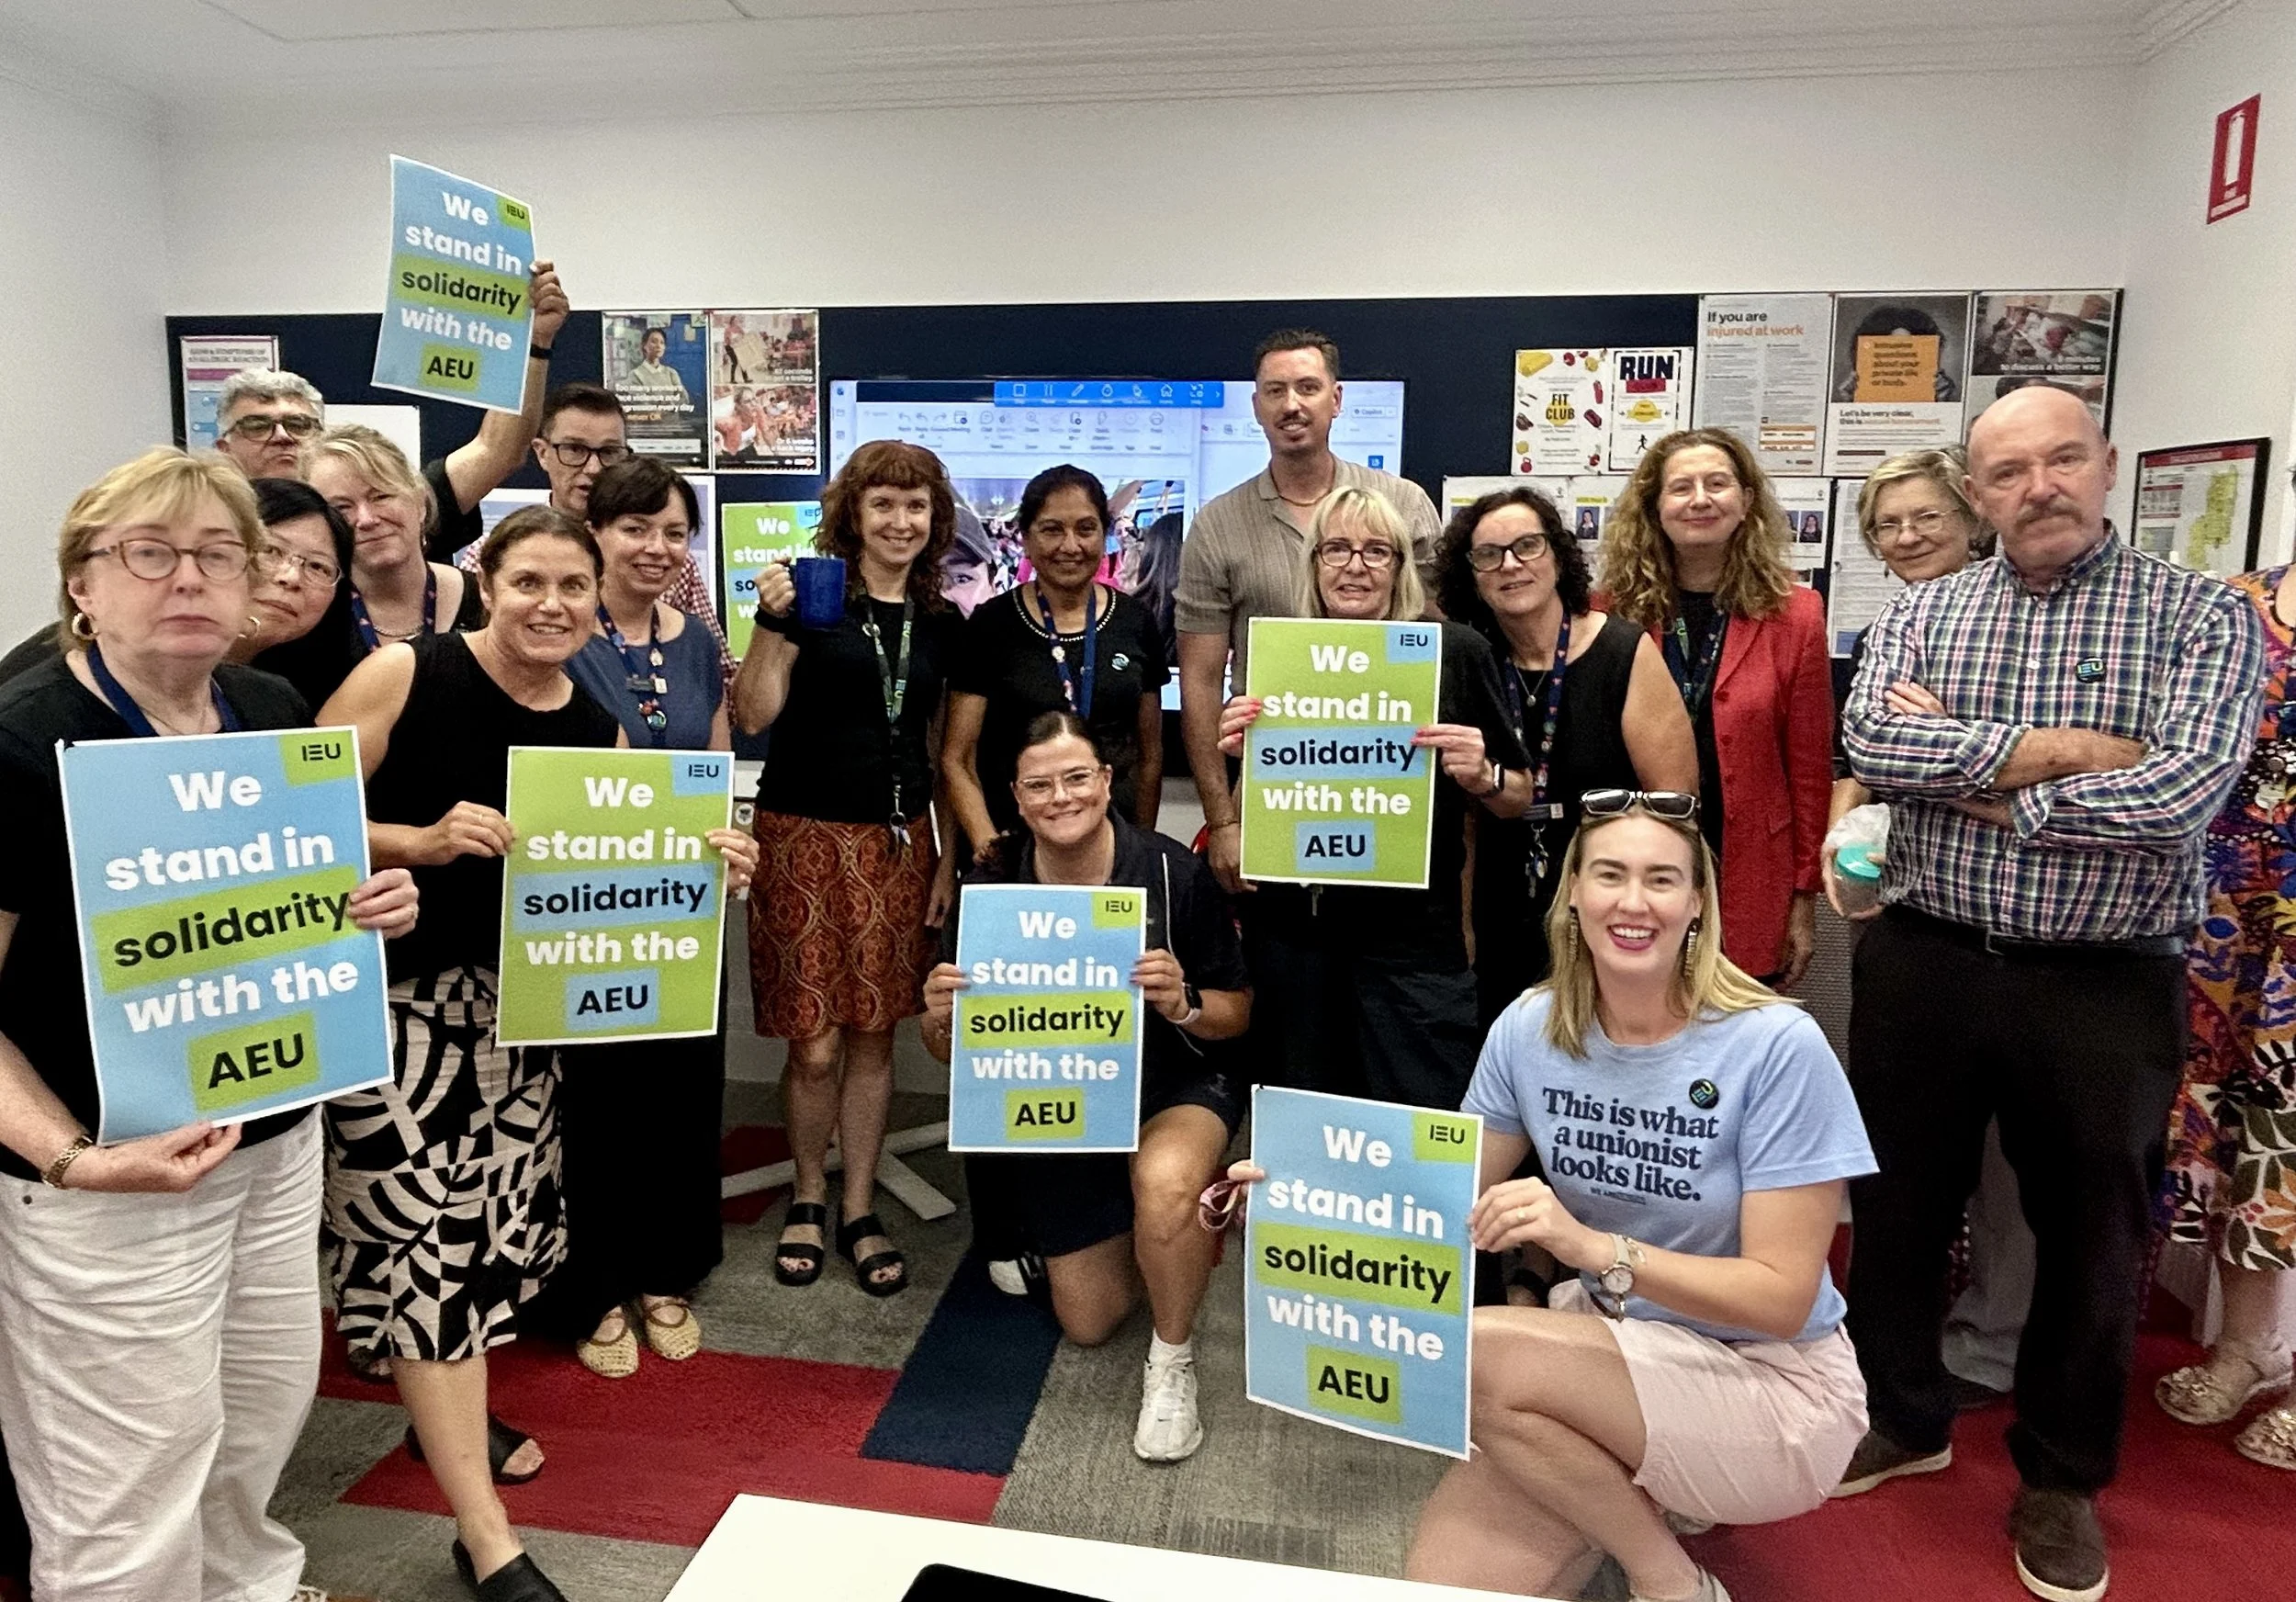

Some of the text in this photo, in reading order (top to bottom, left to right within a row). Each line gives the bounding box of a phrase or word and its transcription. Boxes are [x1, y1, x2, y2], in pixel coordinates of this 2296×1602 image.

[443, 192, 489, 225] We
[507, 204, 525, 219] IEU
[405, 226, 522, 275] stand in
[401, 271, 521, 314] solidarity
[401, 307, 512, 350] with the
[1707, 325, 1804, 338] injured at work
[1708, 311, 1768, 324] If you are
[427, 355, 474, 379] AEU
[1619, 355, 1674, 380] RUN
[1545, 408, 1575, 420] CLUB
[1552, 393, 1569, 406] FIT
[756, 517, 792, 535] We
[1400, 634, 1428, 647] IEU
[1310, 645, 1370, 673] We
[1263, 691, 1412, 722] stand in
[302, 743, 341, 762] IEU
[1261, 738, 1416, 772] solidarity
[689, 764, 719, 778] IEU
[169, 771, 262, 812] We
[584, 777, 654, 808] We
[1263, 782, 1412, 816] with the
[105, 827, 335, 891] stand in
[526, 827, 701, 861] stand in
[1304, 835, 1366, 857] AEU
[523, 878, 707, 916] solidarity
[1105, 900, 1132, 913] IEU
[114, 892, 350, 967] solidarity
[1019, 911, 1076, 940] We
[525, 931, 700, 965] with the
[972, 956, 1118, 987] stand in
[124, 961, 358, 1033] with the
[577, 985, 647, 1015] AEU
[970, 1003, 1125, 1037] solidarity
[208, 1033, 304, 1089] AEU
[972, 1049, 1120, 1080] with the
[1015, 1101, 1076, 1127] AEU
[1543, 1087, 1719, 1139] This is what
[1322, 1124, 1392, 1168] We
[1429, 1124, 1466, 1145] IEU
[1554, 1125, 1702, 1170] a unionist
[1551, 1146, 1629, 1188] looks
[1635, 1162, 1702, 1202] like.
[1266, 1179, 1444, 1240] stand in
[1265, 1243, 1452, 1304] solidarity
[1266, 1294, 1445, 1361] with the
[1318, 1365, 1390, 1404] AEU
